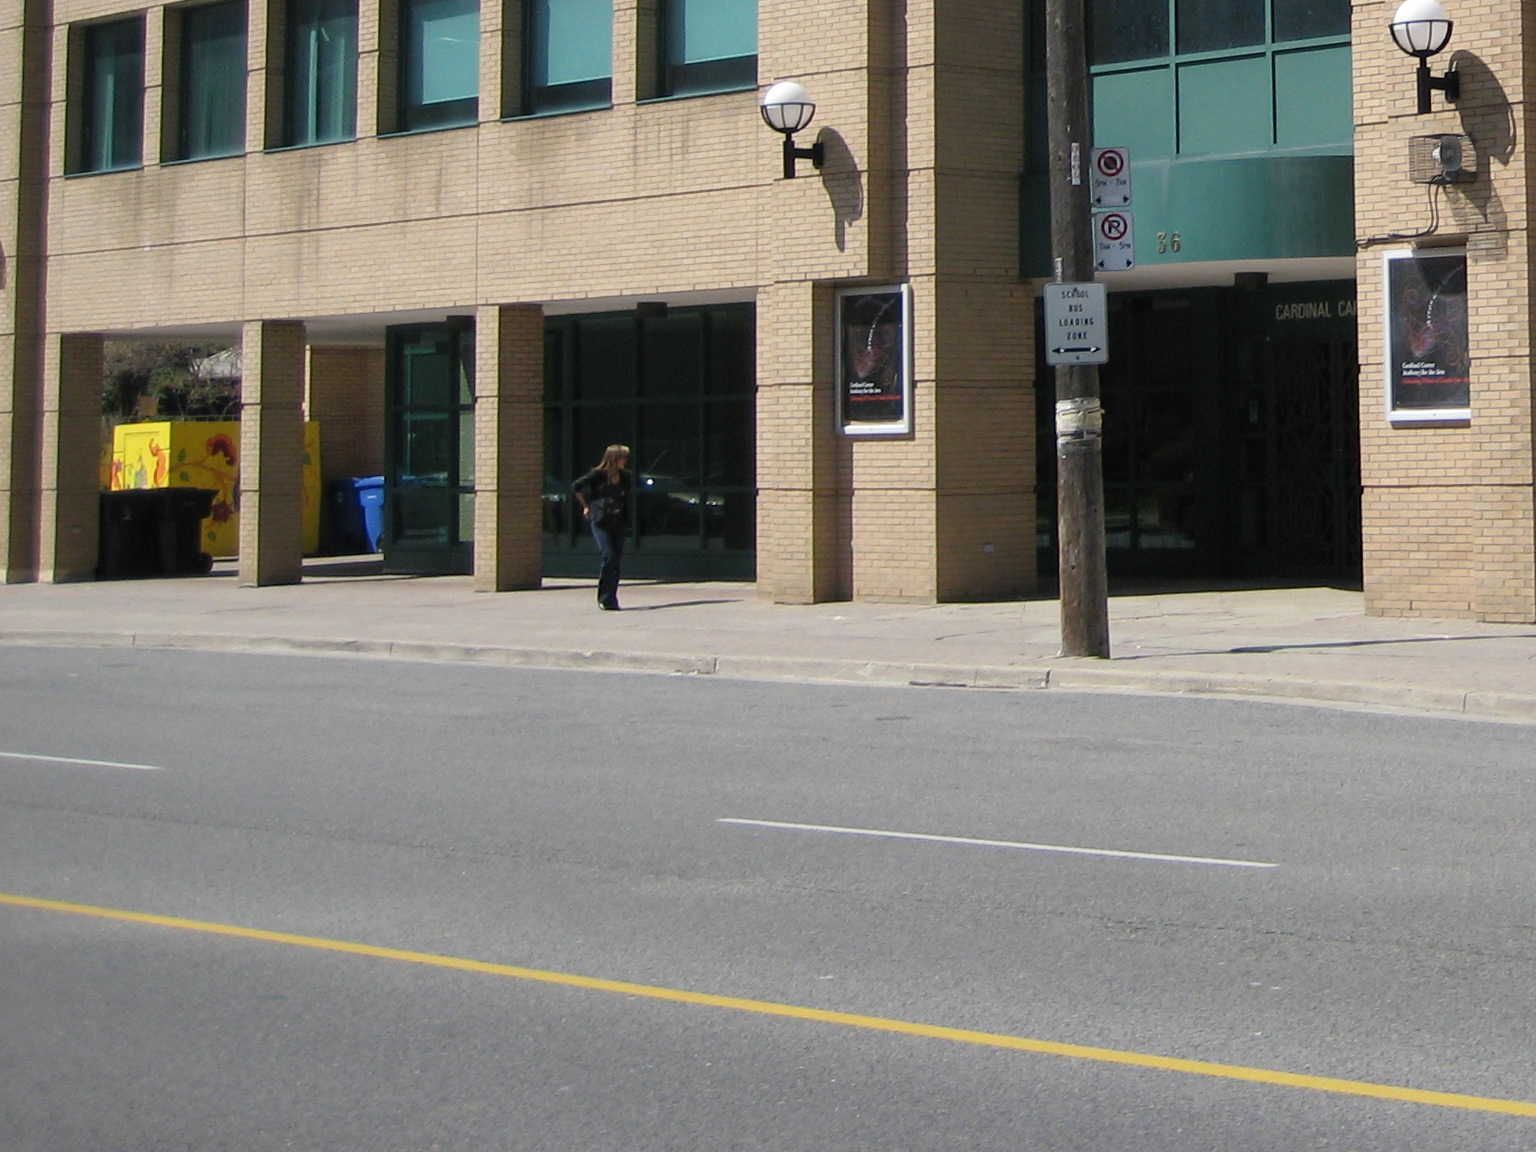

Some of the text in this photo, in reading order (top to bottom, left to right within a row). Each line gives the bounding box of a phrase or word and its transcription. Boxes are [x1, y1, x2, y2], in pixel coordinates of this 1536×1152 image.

[1156, 231, 1182, 254] 36
[1062, 289, 1089, 299] SCHOOL
[1068, 304, 1083, 313] BUS
[1275, 301, 1332, 320] CARDINAL
[1059, 317, 1094, 327] LOADING
[1067, 331, 1087, 341] ZONE
